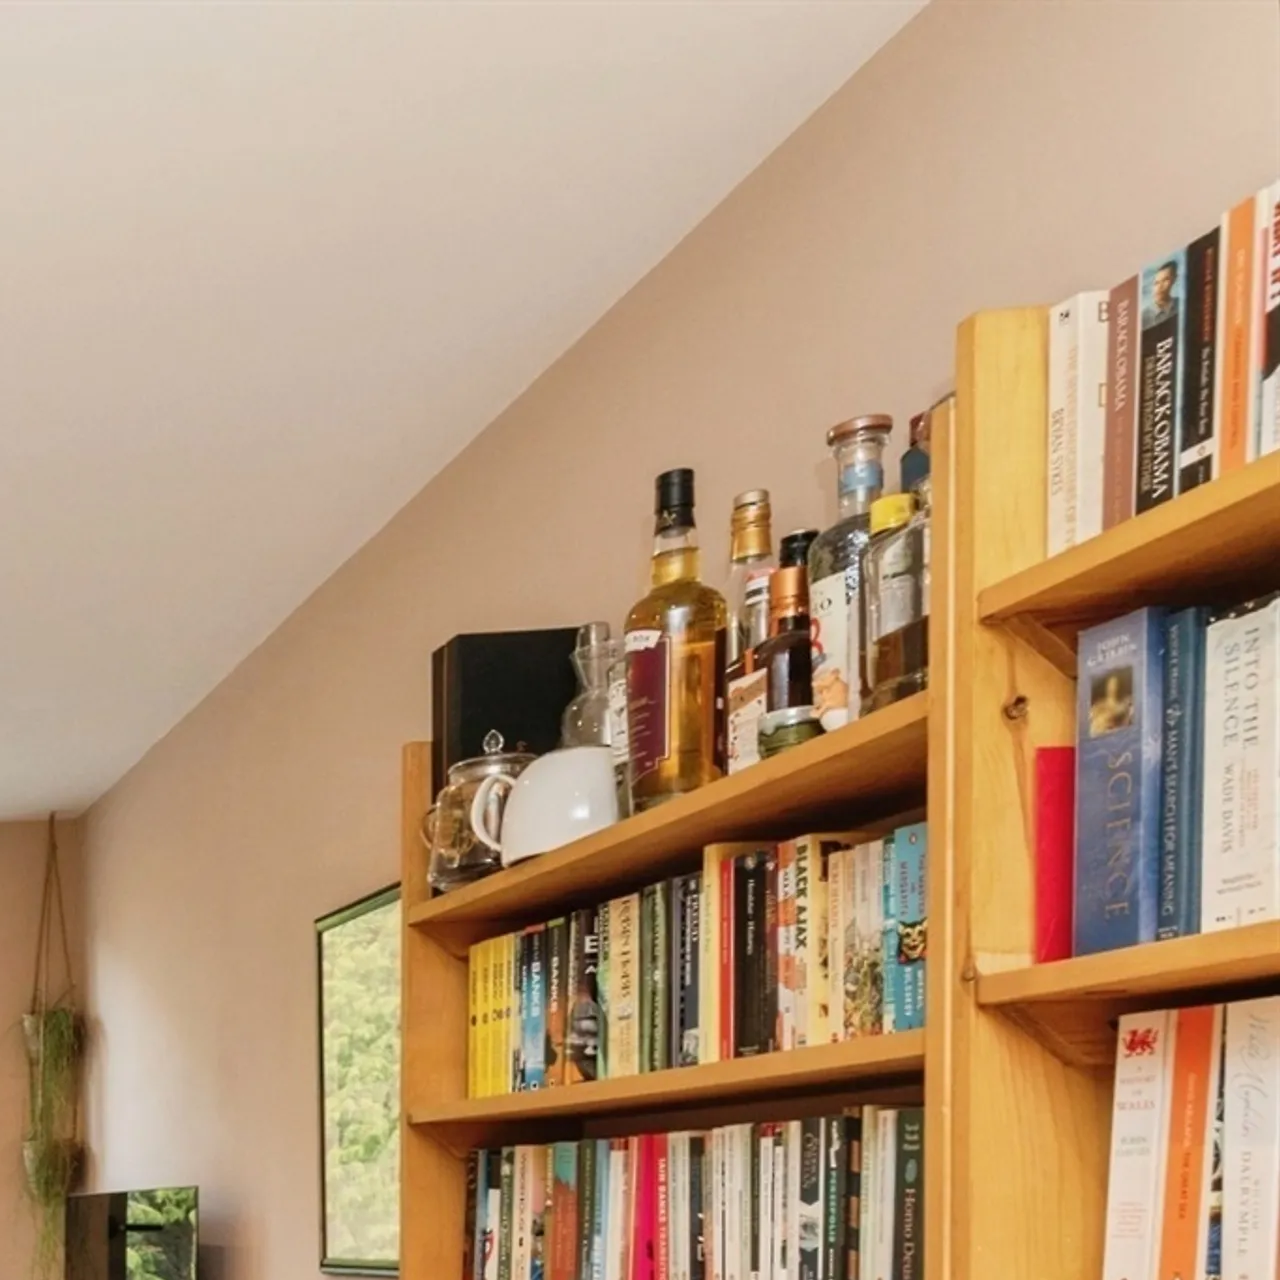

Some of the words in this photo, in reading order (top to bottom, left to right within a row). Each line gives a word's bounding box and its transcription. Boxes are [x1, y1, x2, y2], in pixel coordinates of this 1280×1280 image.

[1116, 300, 1130, 358] BARACK
[1115, 358, 1128, 412] OBAMA
[1145, 357, 1155, 400] DREAMS
[1153, 337, 1173, 418] BARACK
[1142, 434, 1152, 453] MY
[1143, 401, 1154, 433] FROM
[1141, 454, 1151, 496] FATHER
[1152, 419, 1172, 500] OBAMA
[1243, 627, 1260, 693] INTO
[1223, 642, 1242, 749] SILENCE
[1243, 701, 1260, 751] THE
[1163, 774, 1178, 826] SEARCH
[1223, 763, 1235, 807] WADE
[1103, 750, 1133, 921] SCIENCE
[1163, 827, 1177, 857] FOR
[1221, 810, 1234, 855] DAVIS
[796, 844, 809, 899] BLACK
[899, 861, 909, 918] MARGARITA
[1162, 857, 1178, 917] MEANING
[795, 905, 808, 950] AJAX
[530, 962, 541, 1018] BANKS
[551, 956, 560, 1014] BANKS
[658, 1158, 667, 1182] IAIN
[658, 1185, 667, 1224] BANKS
[828, 1170, 837, 1243] PERSEPOLIS
[903, 1188, 916, 1238] Homo
[1238, 1150, 1252, 1259] DALRYMPLE
[902, 1241, 915, 1280] Deus
